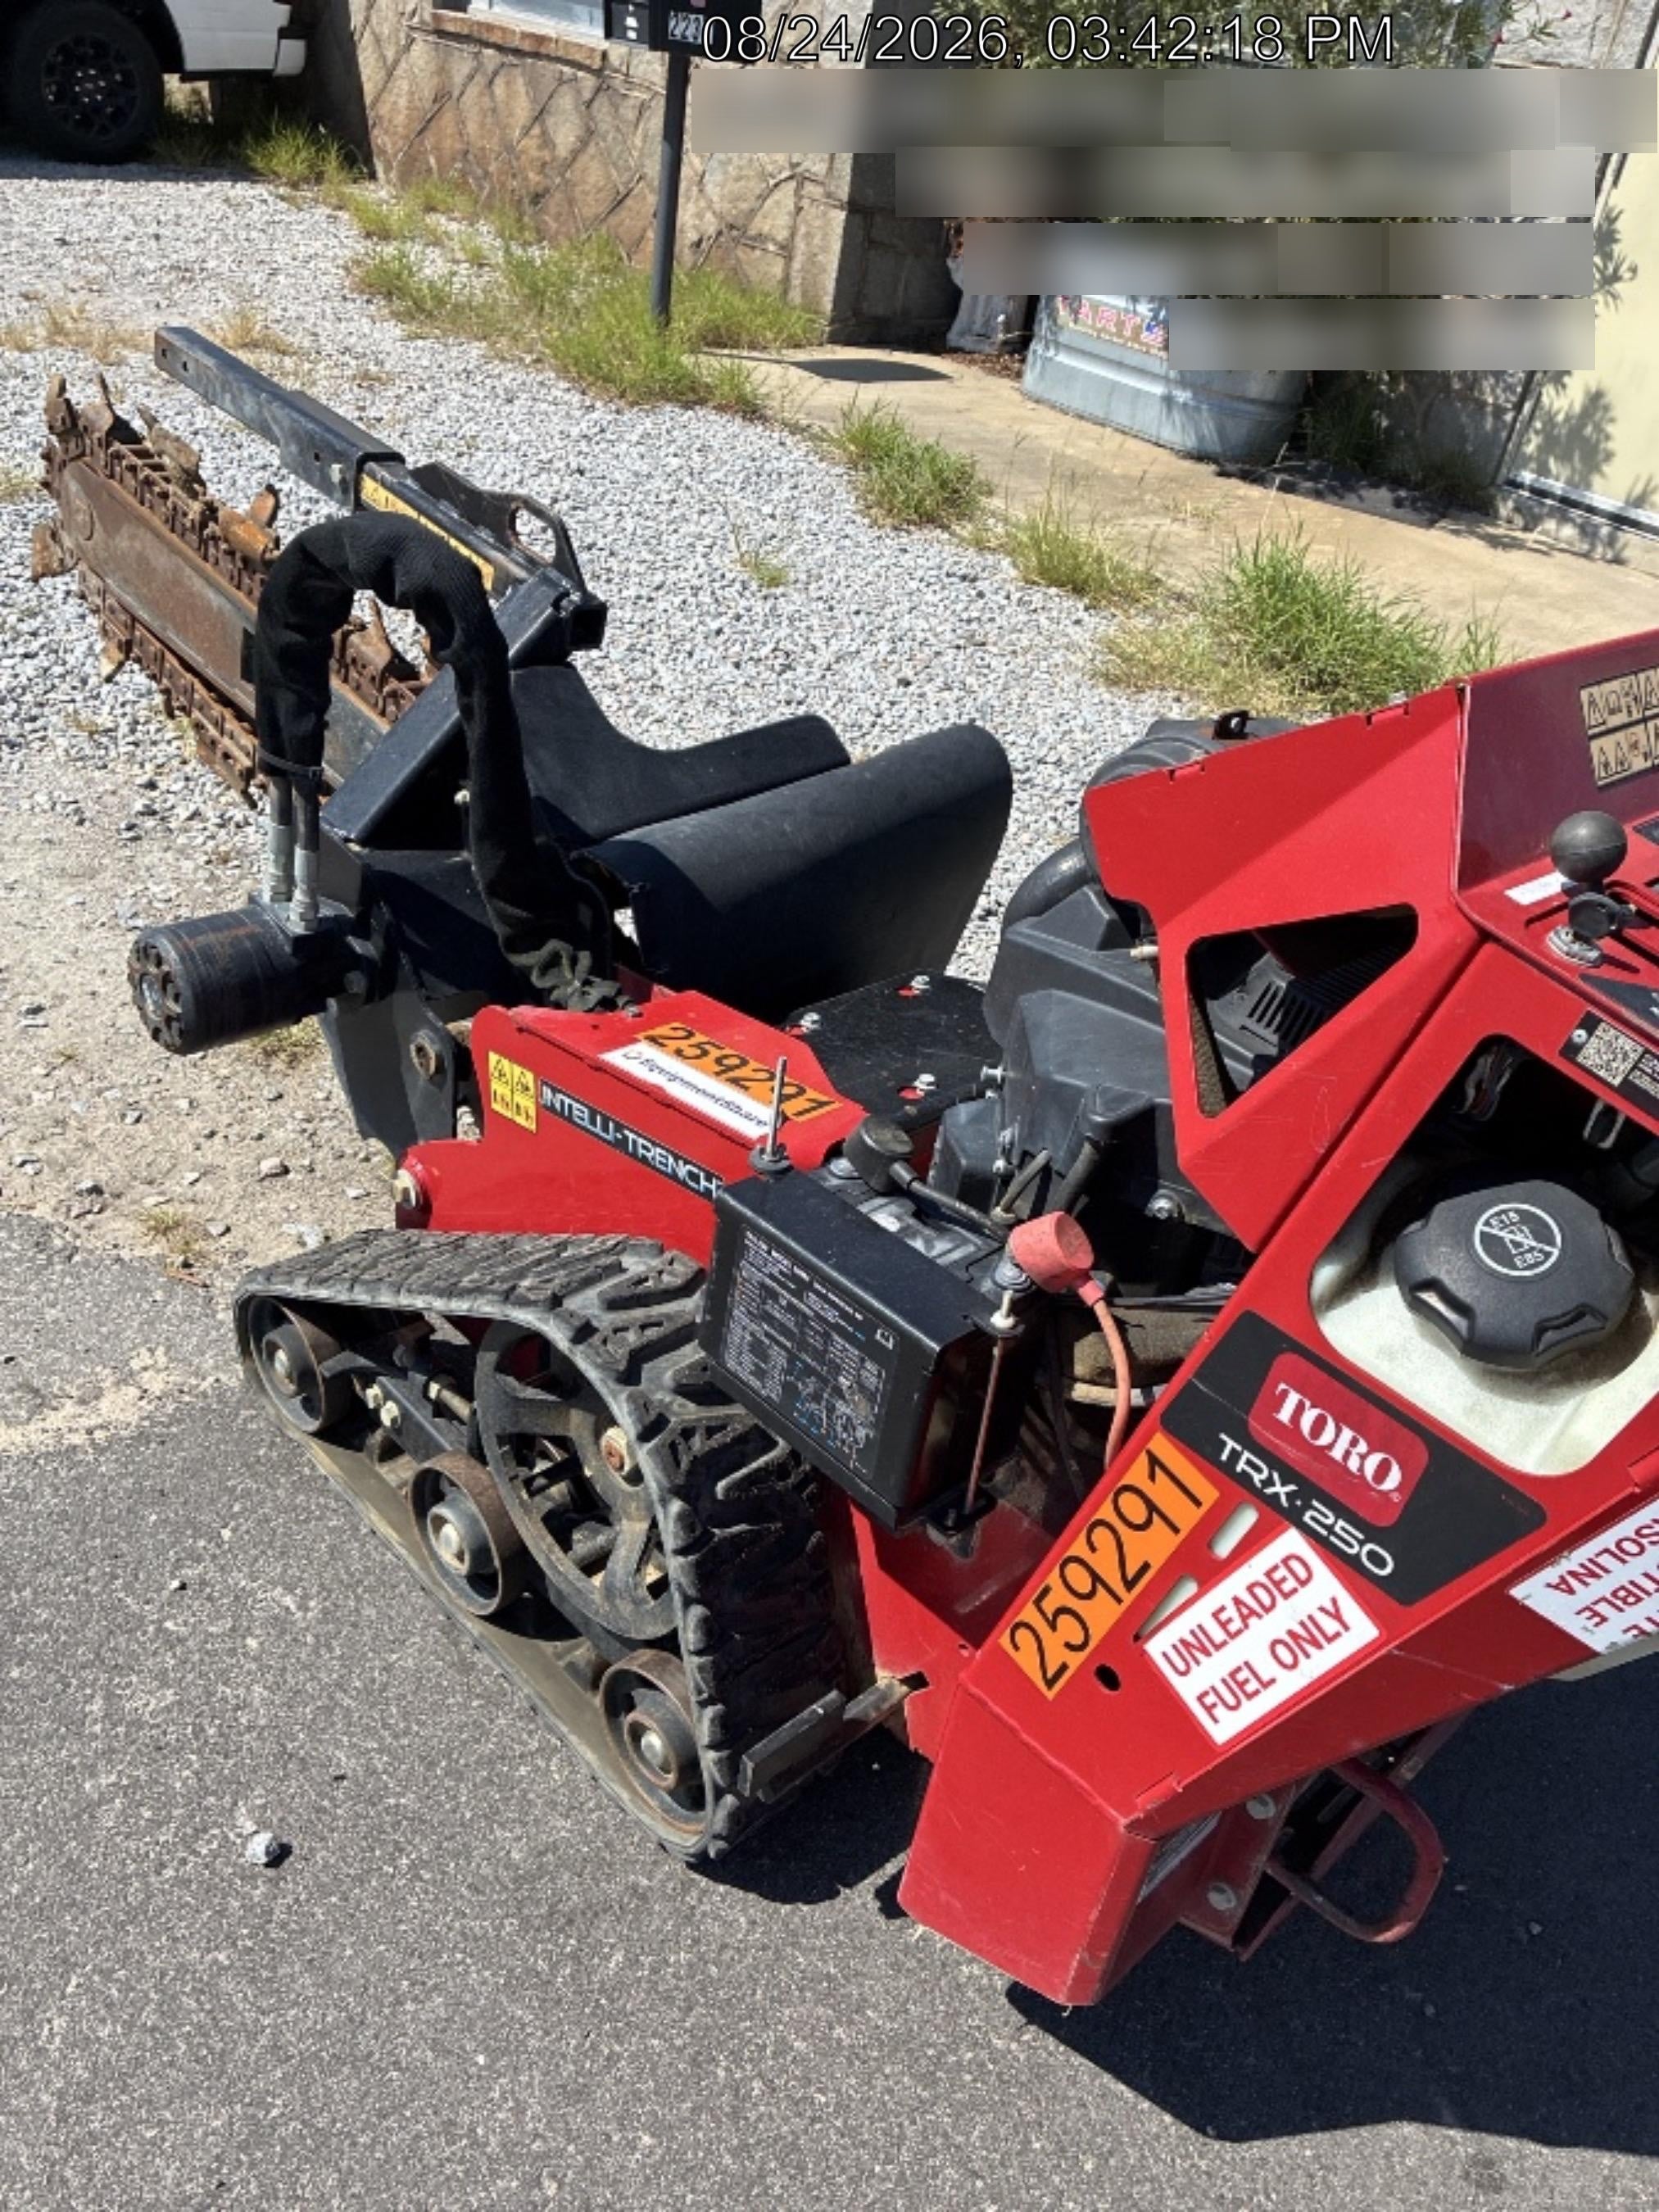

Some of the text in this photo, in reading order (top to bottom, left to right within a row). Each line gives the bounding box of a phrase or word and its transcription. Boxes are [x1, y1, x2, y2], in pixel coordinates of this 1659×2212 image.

[643, 1025, 836, 1119] 259291
[1272, 1381, 1403, 1492] TORO
[1009, 1448, 1203, 1691] 259291
[1544, 1517, 1659, 1596] SOLINA
[1575, 1562, 1659, 1628] TIBLE
[1162, 1553, 1313, 1677] UNLEADED
[1196, 1596, 1351, 1724] FUEL ONLY
